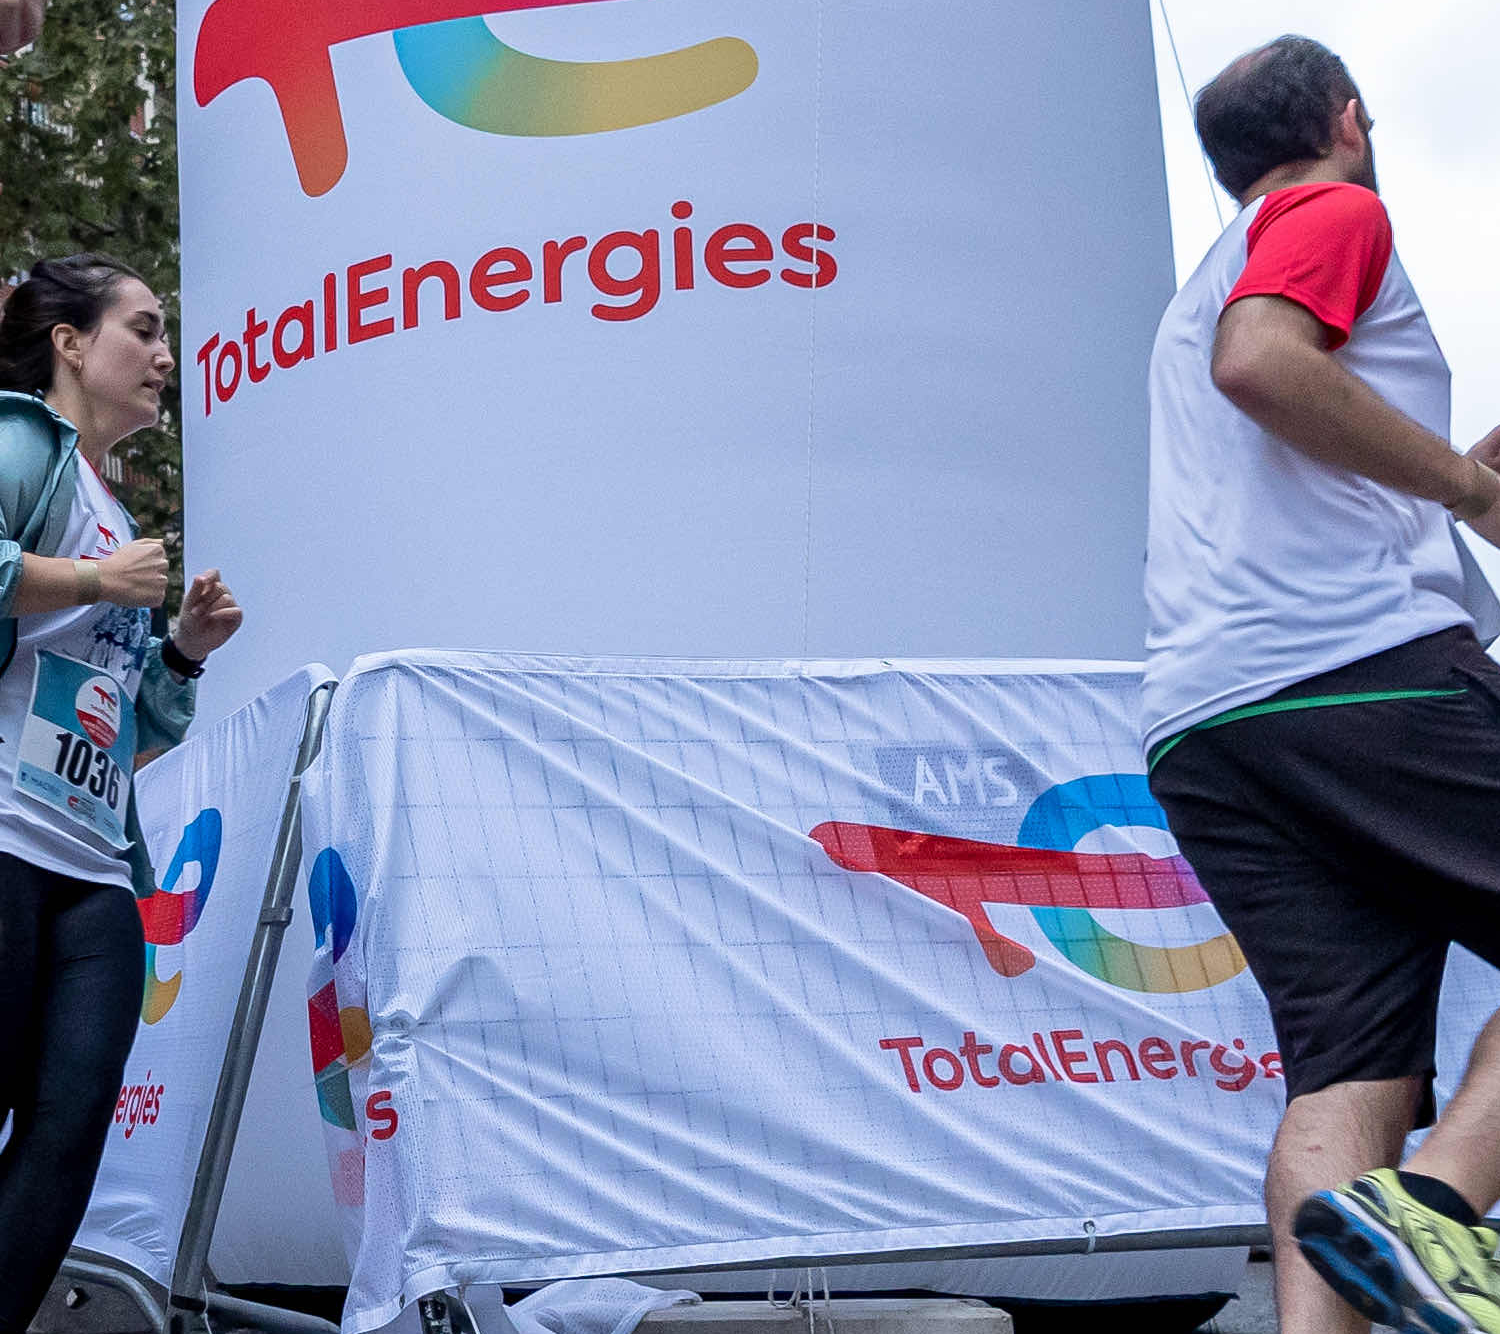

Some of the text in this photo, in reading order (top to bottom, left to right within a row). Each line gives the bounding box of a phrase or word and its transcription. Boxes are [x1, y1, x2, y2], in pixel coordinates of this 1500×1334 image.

[196, 200, 838, 418] TotalEnergies
[55, 731, 121, 810] 1036
[912, 754, 1019, 806] AMS
[878, 1029, 1284, 1092] TotalEnerg
